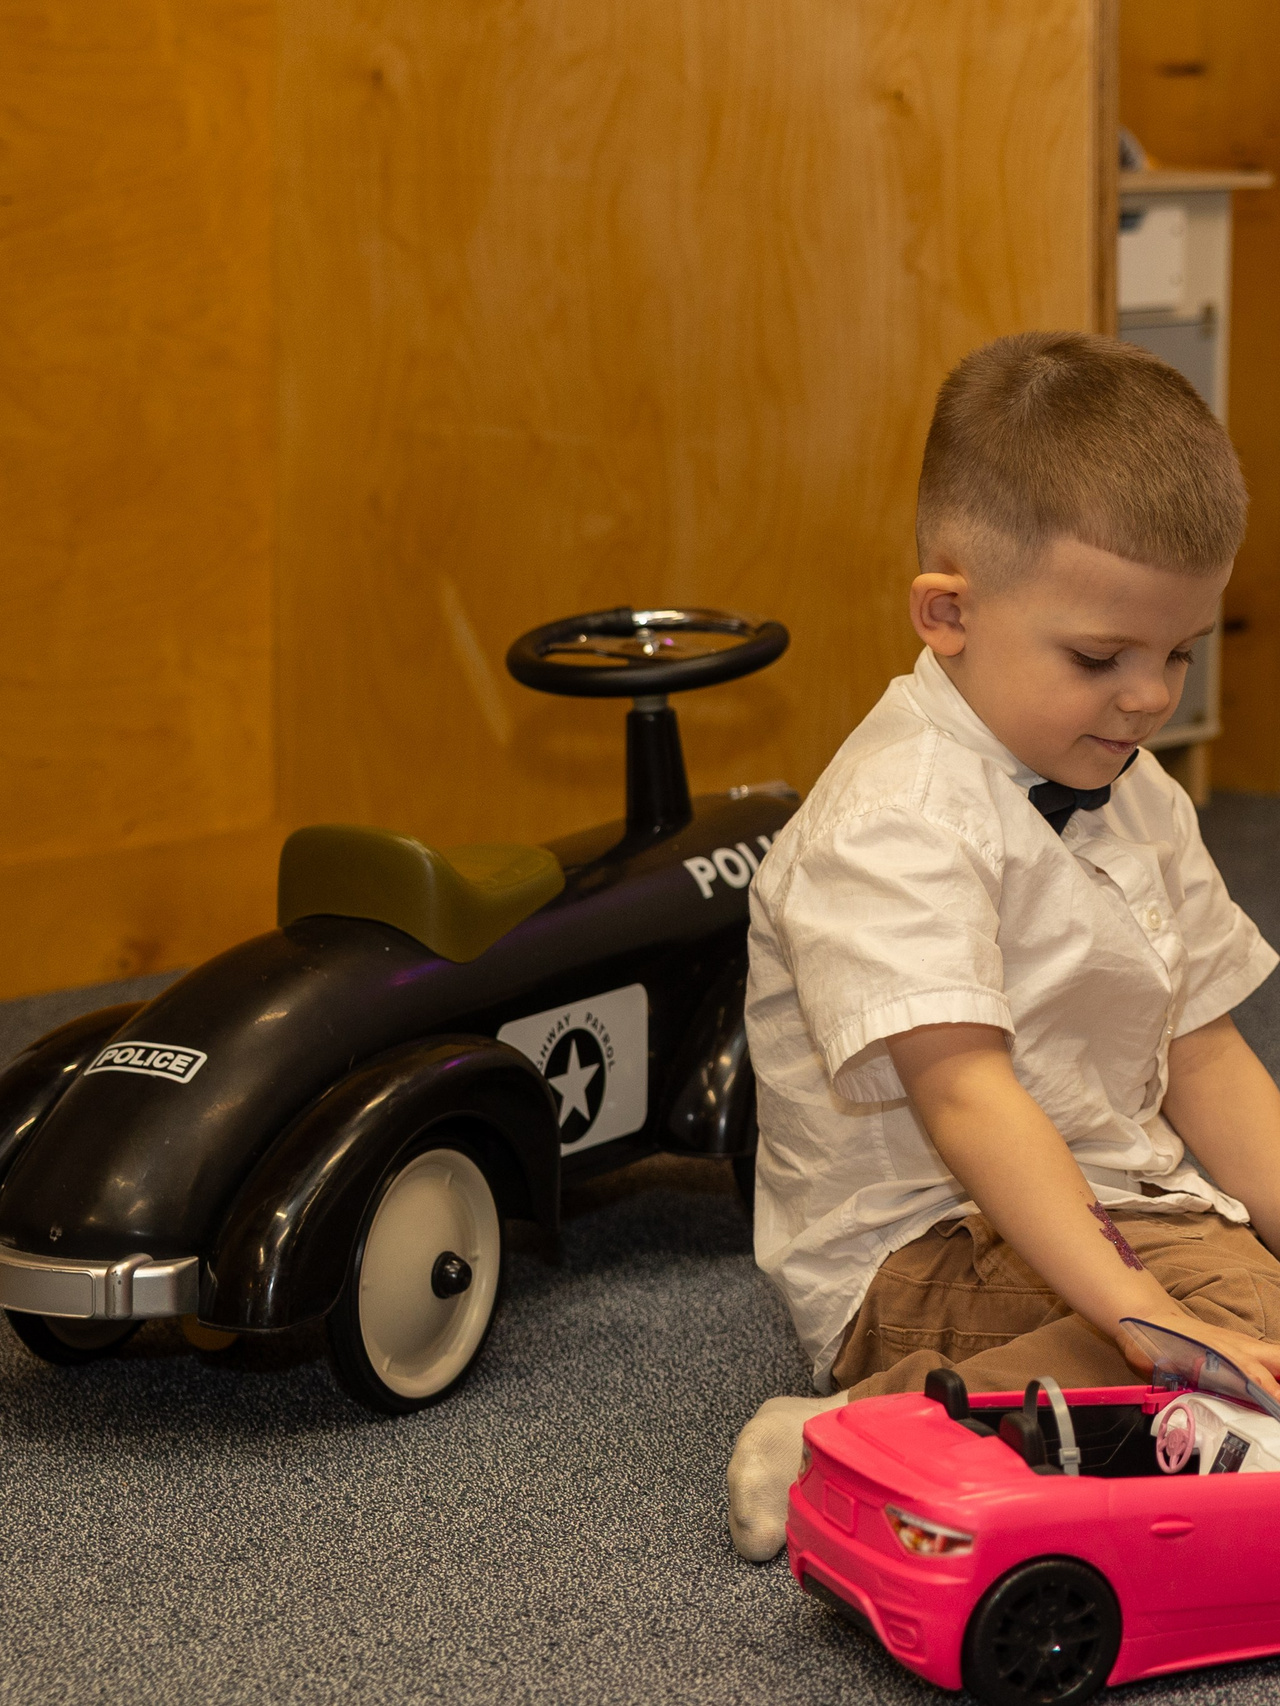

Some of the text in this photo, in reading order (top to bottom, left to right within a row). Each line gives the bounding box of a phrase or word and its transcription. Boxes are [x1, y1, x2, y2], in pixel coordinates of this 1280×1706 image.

[96, 1047, 194, 1074] POLICE
[536, 1012, 616, 1073] GHWAY PATROL
